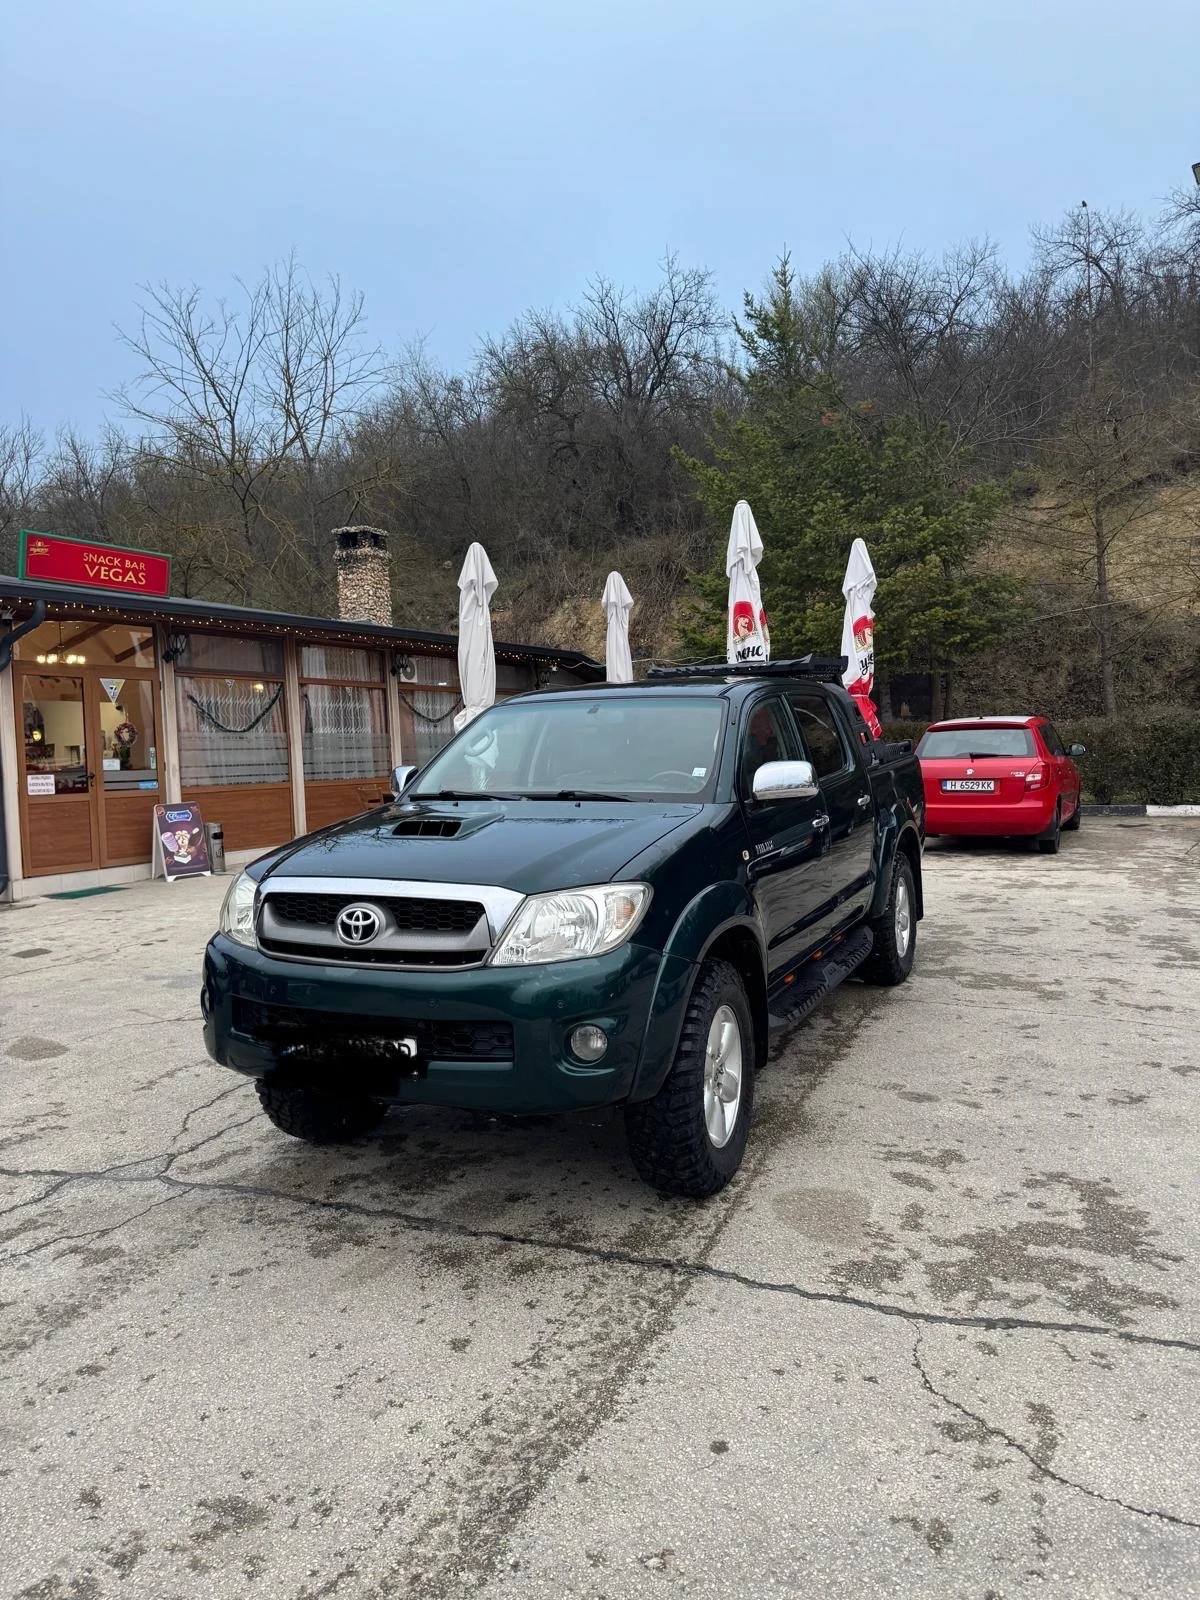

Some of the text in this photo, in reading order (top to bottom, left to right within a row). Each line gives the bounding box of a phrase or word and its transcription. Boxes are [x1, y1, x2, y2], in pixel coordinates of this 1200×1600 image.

[83, 552, 146, 571] SNACK BAR
[84, 564, 146, 585] VEGAS
